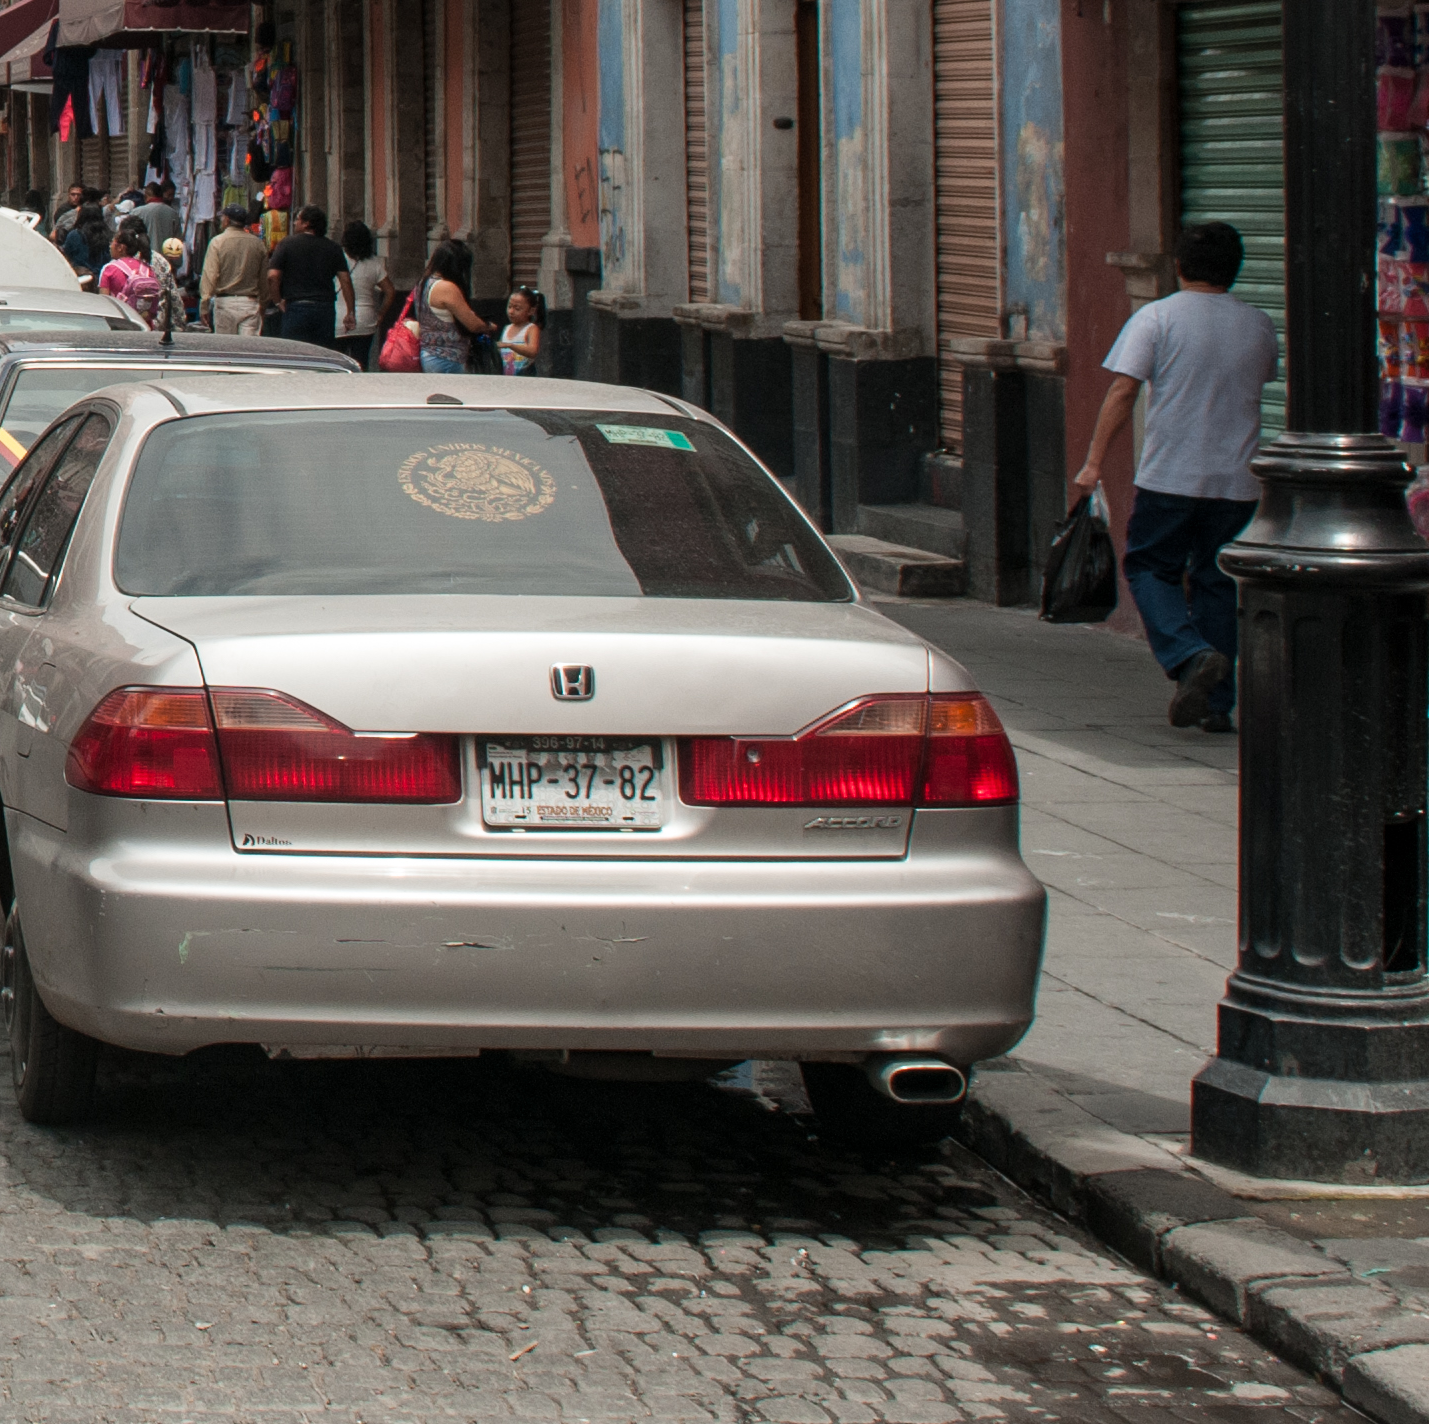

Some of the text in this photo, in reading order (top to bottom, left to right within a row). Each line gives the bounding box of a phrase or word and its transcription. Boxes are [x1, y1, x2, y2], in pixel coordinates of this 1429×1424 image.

[427, 443, 487, 454] UNIDOS
[488, 761, 656, 801] MHP-37-82
[537, 805, 568, 816] ESTADO
[569, 806, 580, 816] DE
[804, 816, 902, 830] ACCORD
